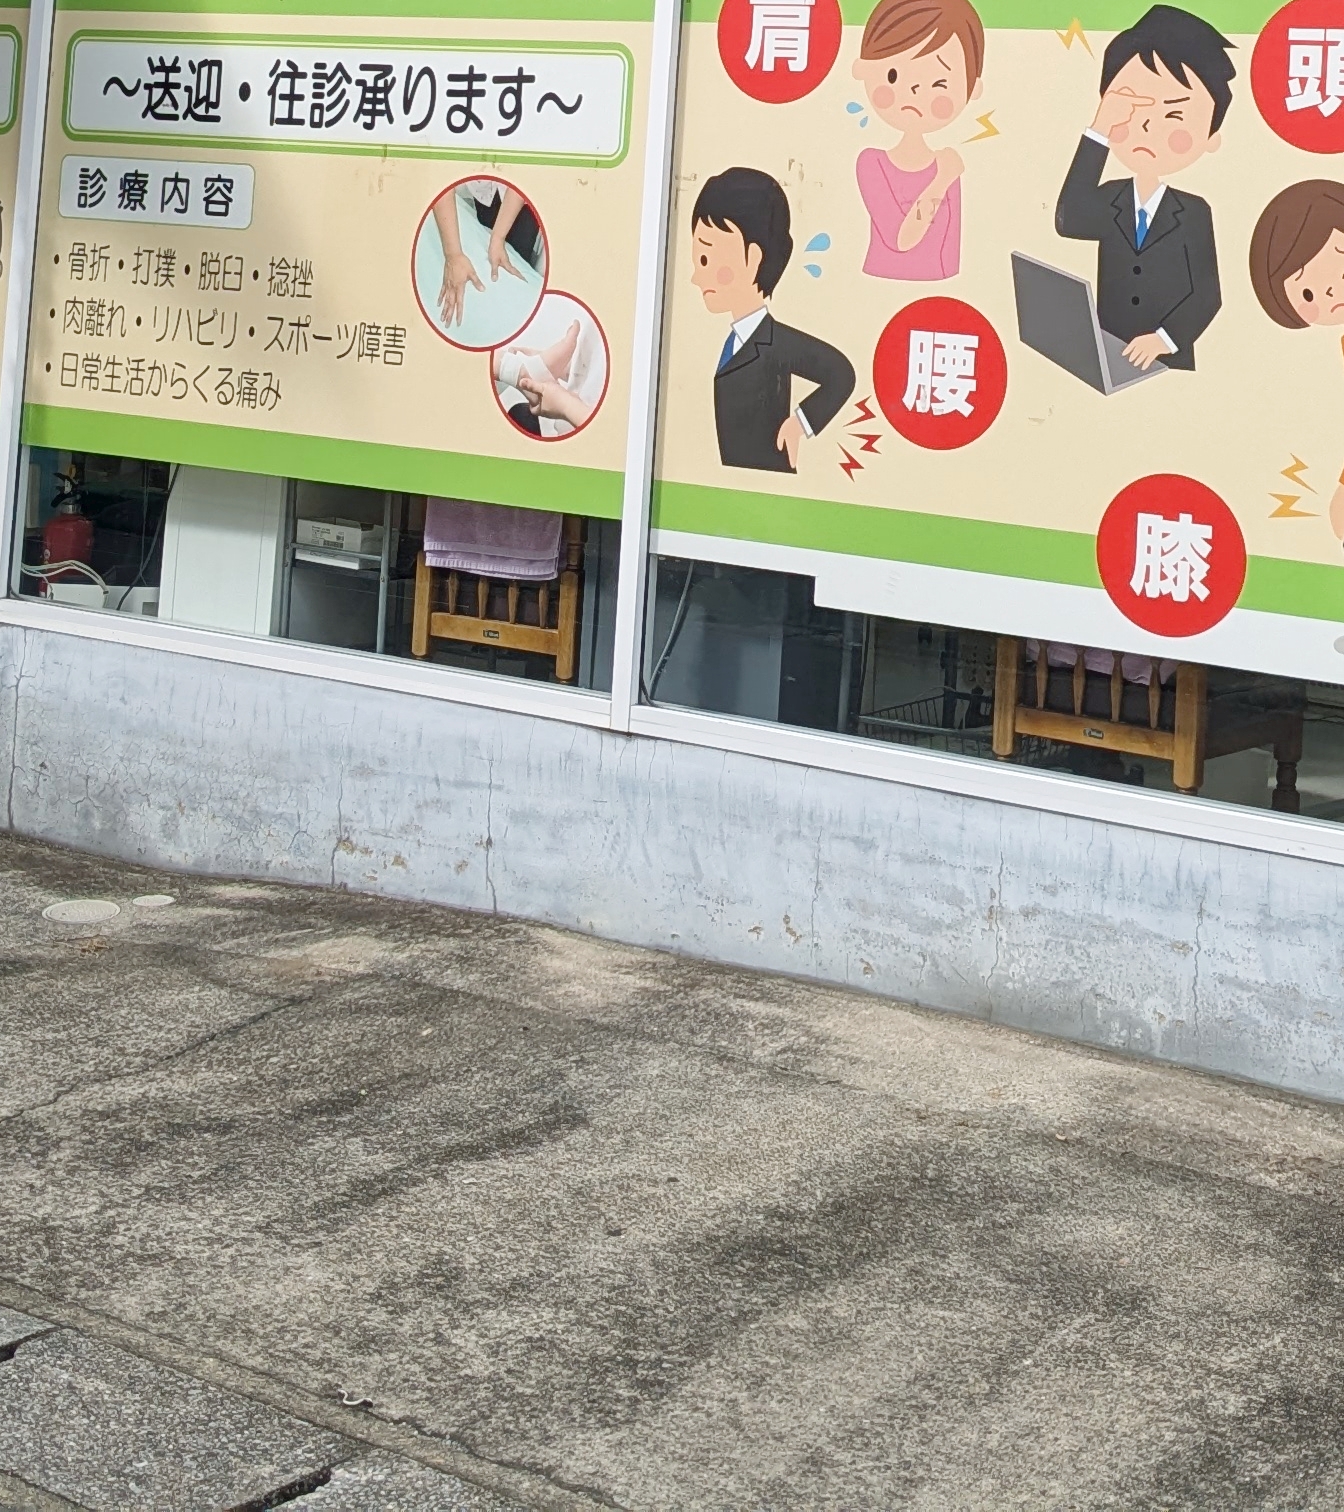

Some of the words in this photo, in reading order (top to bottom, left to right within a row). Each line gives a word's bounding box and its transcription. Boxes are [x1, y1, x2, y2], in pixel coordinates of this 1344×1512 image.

[76, 167, 235, 218] 診療内容
[901, 330, 979, 418] 腰
[1129, 513, 1213, 603] 膝
